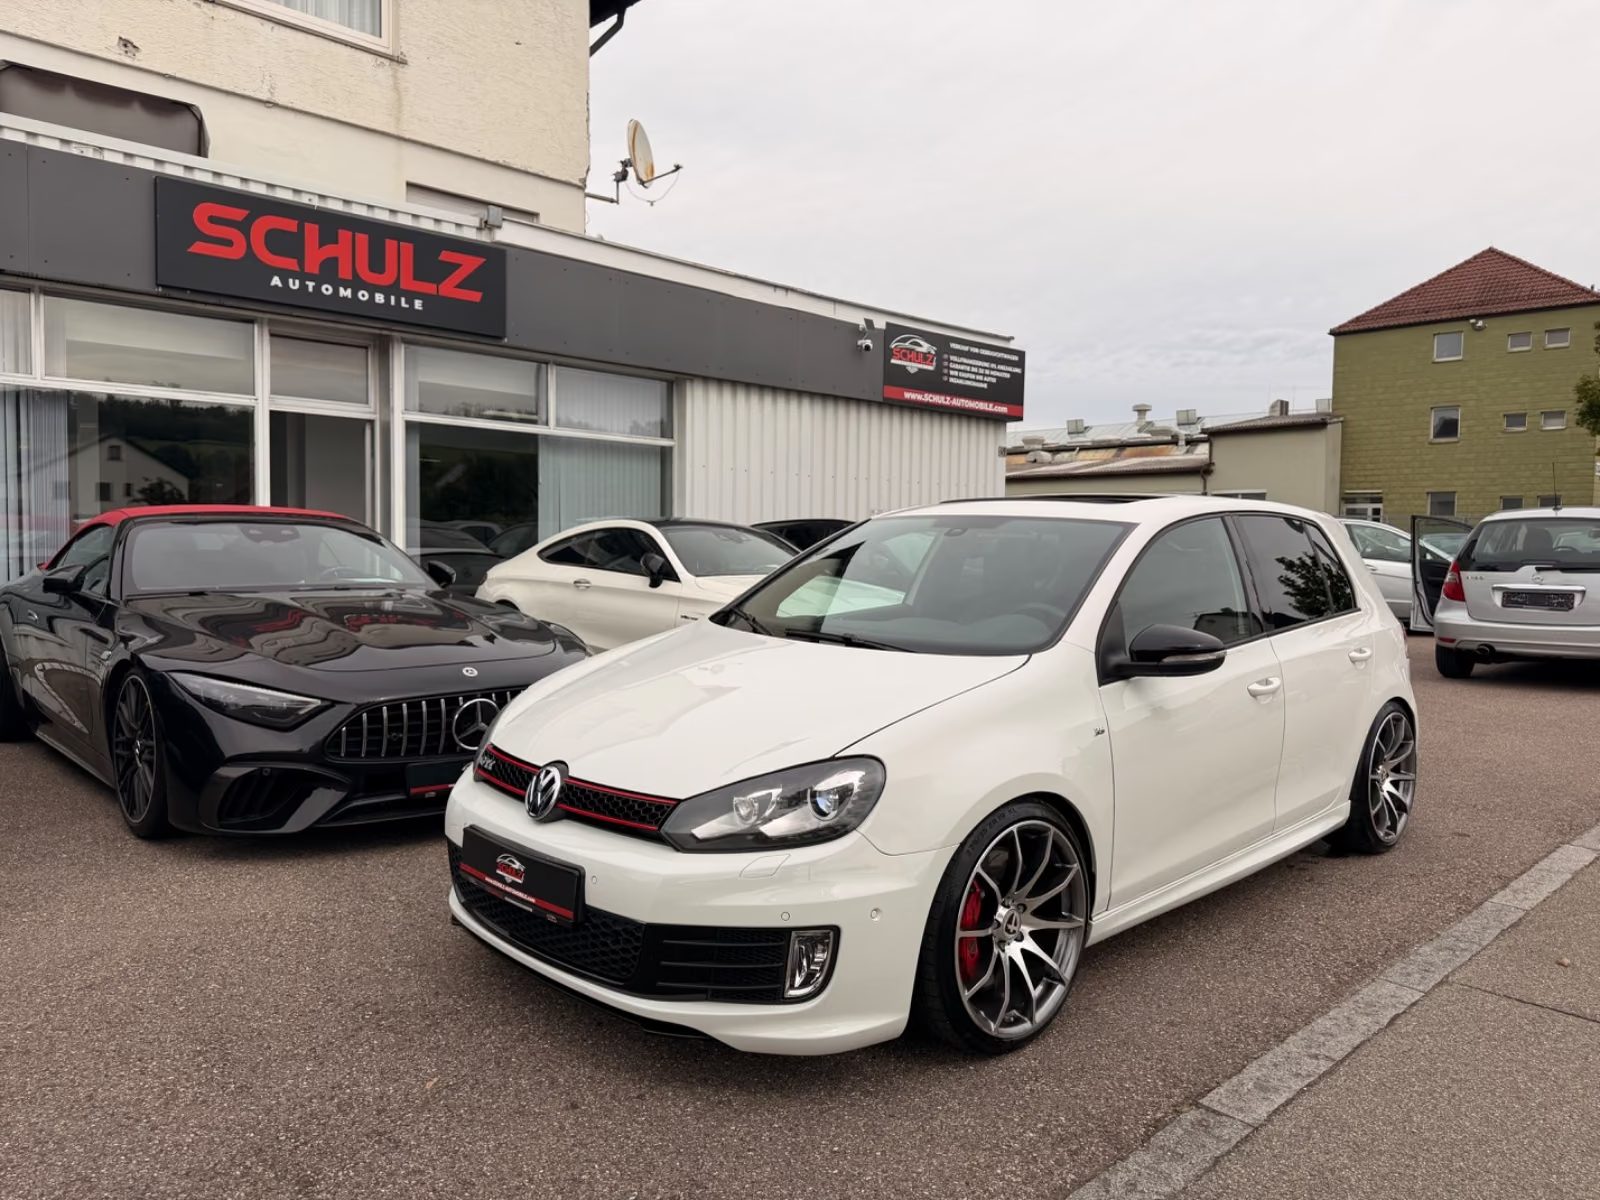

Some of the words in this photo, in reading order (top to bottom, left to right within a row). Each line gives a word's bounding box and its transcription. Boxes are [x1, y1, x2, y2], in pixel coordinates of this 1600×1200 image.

[187, 202, 487, 302] SCHULZ
[270, 275, 424, 310] AUTOMOBILE
[892, 347, 935, 366] SCHULZ
